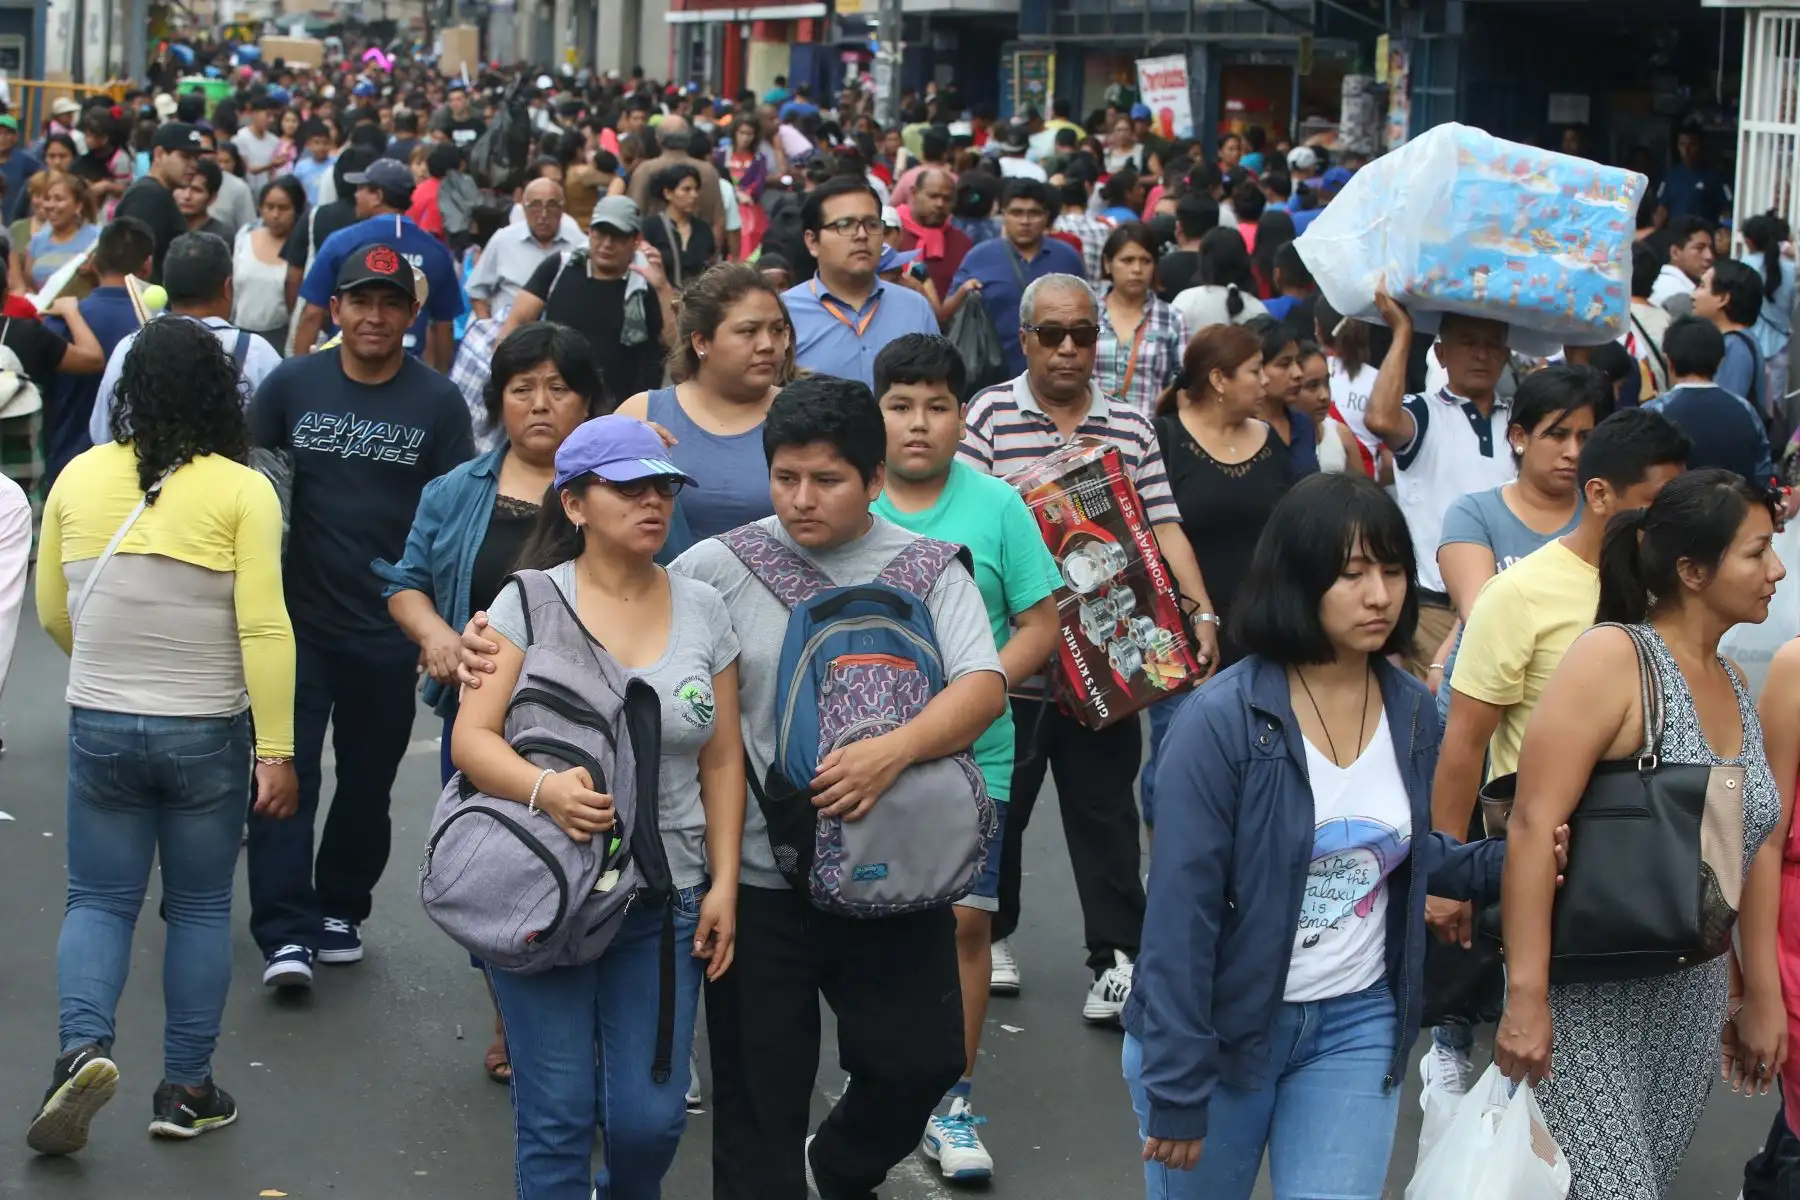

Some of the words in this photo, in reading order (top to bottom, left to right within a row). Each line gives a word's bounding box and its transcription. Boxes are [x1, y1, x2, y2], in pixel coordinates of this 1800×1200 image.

[292, 411, 425, 448] ARMANI
[293, 434, 420, 465] EXCHANGE
[1119, 496, 1135, 518] SET
[1131, 523, 1168, 596] COOKWARE
[1062, 625, 1089, 677] KITCHEN
[1085, 678, 1109, 718] GINA'S
[1319, 856, 1359, 869] The
[1355, 868, 1368, 877] of
[1346, 873, 1370, 885] the
[1305, 879, 1356, 917] alaxy
[1312, 901, 1327, 914] is
